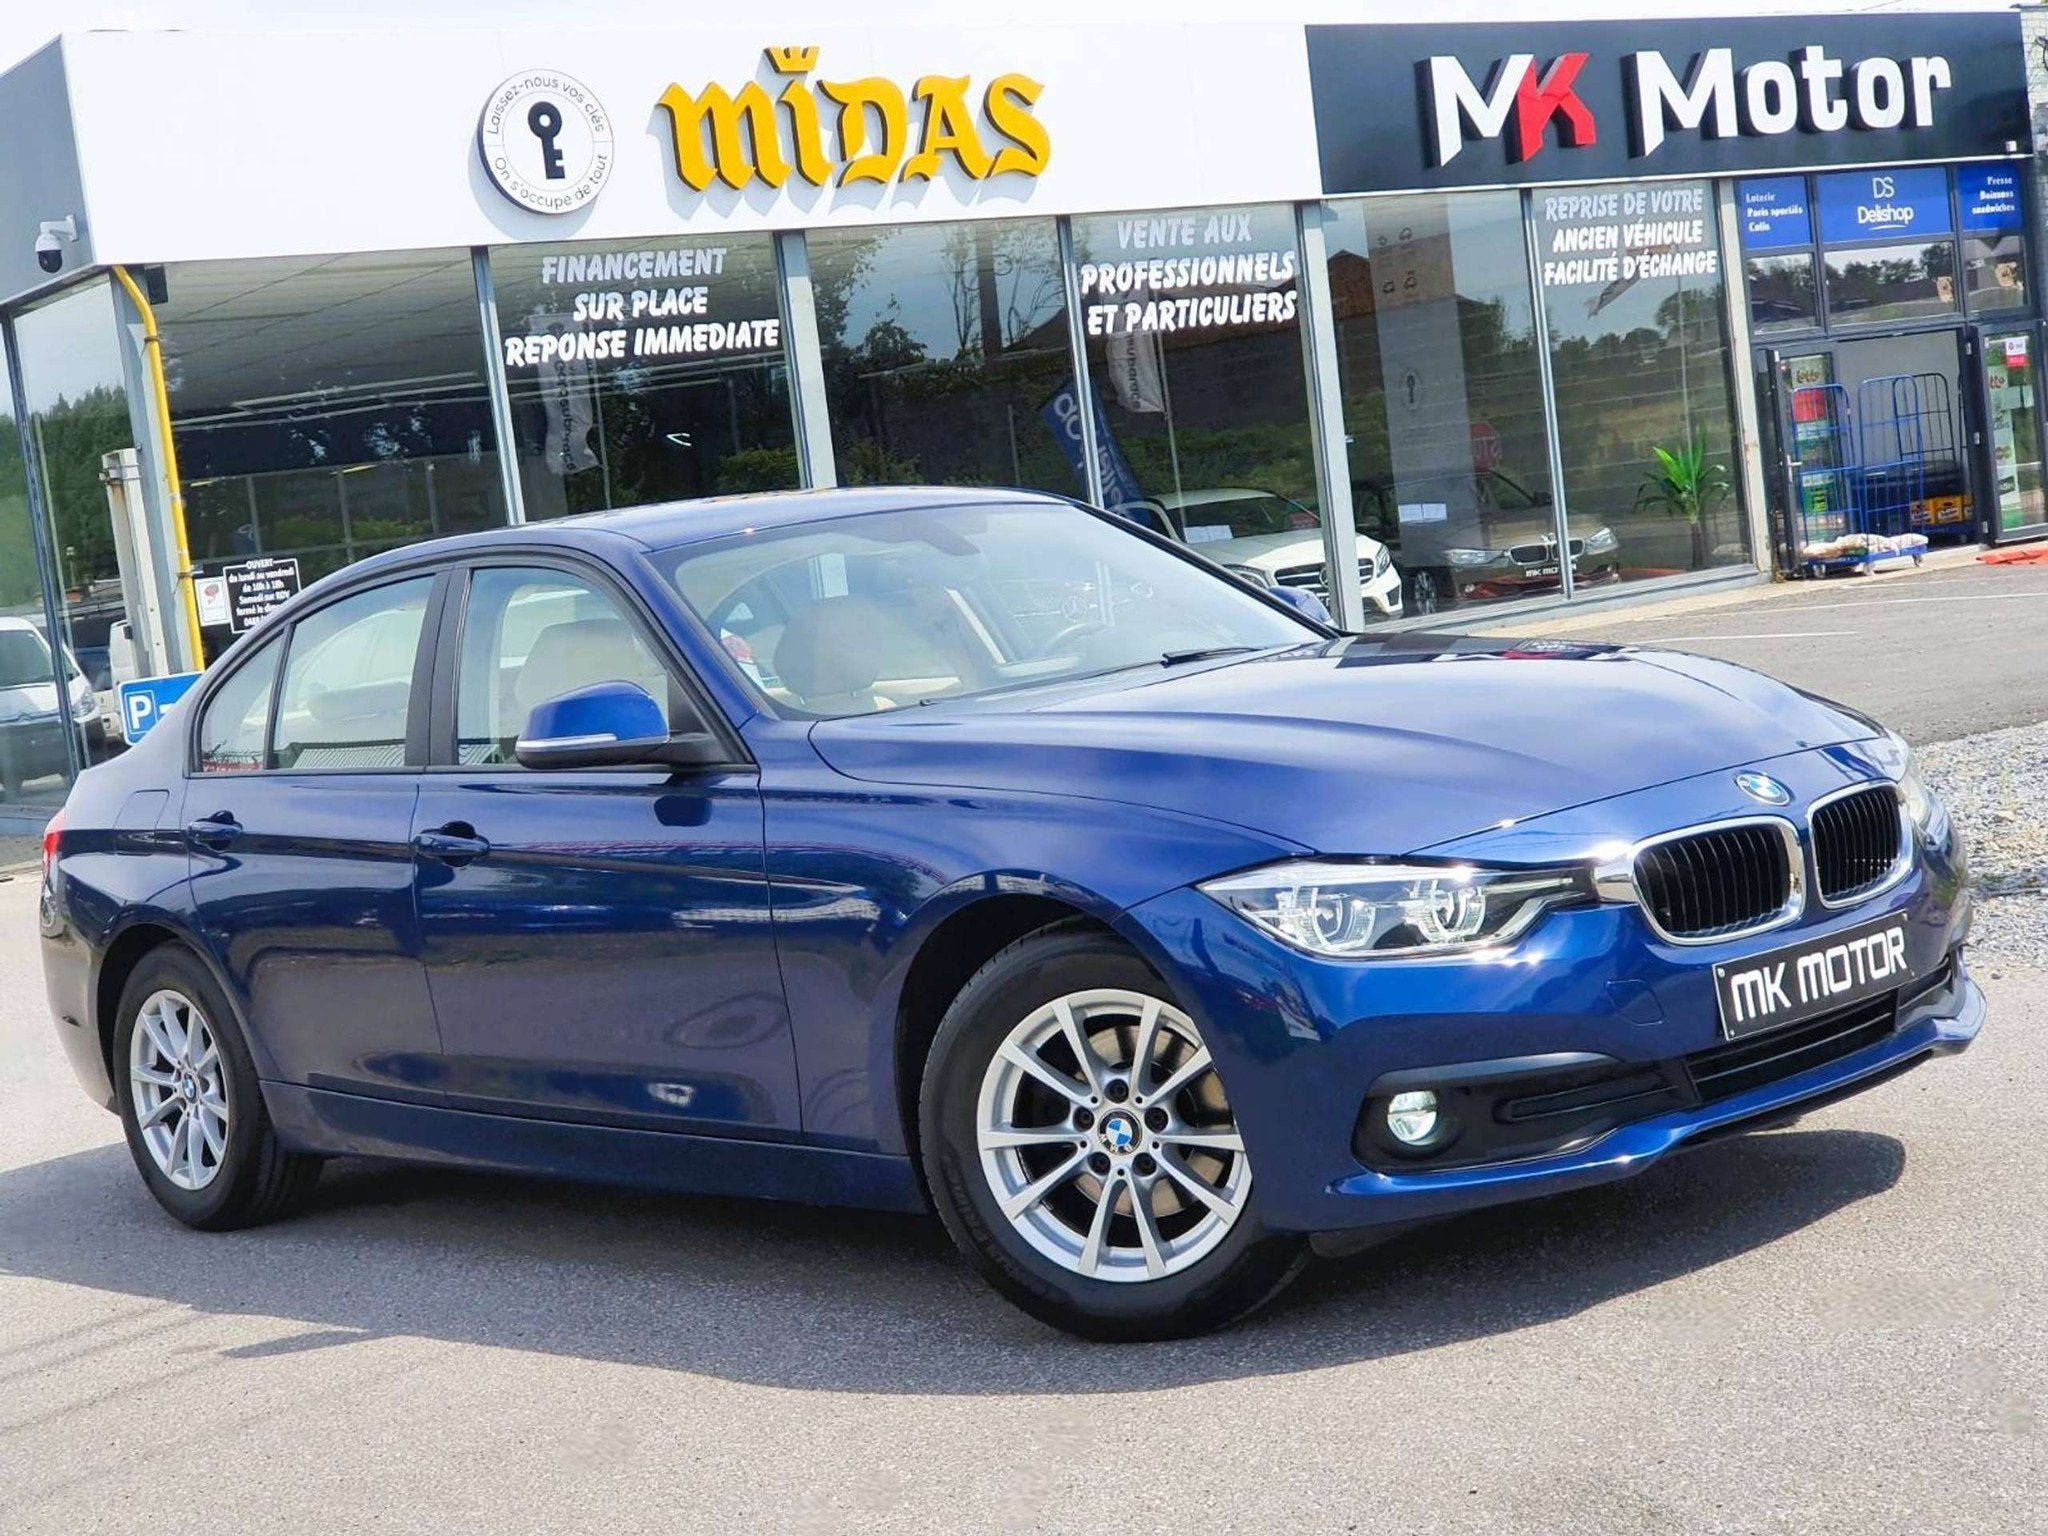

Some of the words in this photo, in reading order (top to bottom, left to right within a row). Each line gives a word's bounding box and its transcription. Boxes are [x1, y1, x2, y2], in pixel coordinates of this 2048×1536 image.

[562, 82, 586, 103] vos
[1429, 52, 1596, 166] MK
[1634, 45, 1951, 157] Motor
[494, 157, 511, 181] On
[574, 183, 592, 201] de
[588, 153, 608, 185] tout
[1873, 176, 1895, 199] DS
[1544, 194, 1618, 222] REPRISE
[1623, 191, 1646, 215] DE
[1650, 188, 1704, 214] VOTRE
[1857, 206, 1914, 225] Delishop
[1117, 216, 1196, 250] VENTE
[1203, 213, 1253, 245] AUX
[1552, 225, 1619, 253] ANCIEN
[1622, 219, 1704, 248] VÉHICULE
[542, 248, 727, 284] FINANCEMENT
[1080, 251, 1296, 295] PROFESSIONNELS
[1544, 251, 1619, 287] FACILITÉ
[1623, 248, 1718, 279] D'ÉCHANGE
[573, 291, 624, 322] SUR
[631, 286, 709, 318] PLACE
[1087, 304, 1119, 336] ET
[1125, 290, 1298, 333] PARTICULIERS
[504, 329, 627, 368] REPONSE
[633, 318, 780, 356] IMMEDIATE
[245, 558, 274, 570] OUVERT
[128, 694, 151, 730] P
[1730, 961, 1792, 1023] MK
[1796, 926, 1908, 1004] MOTOR
